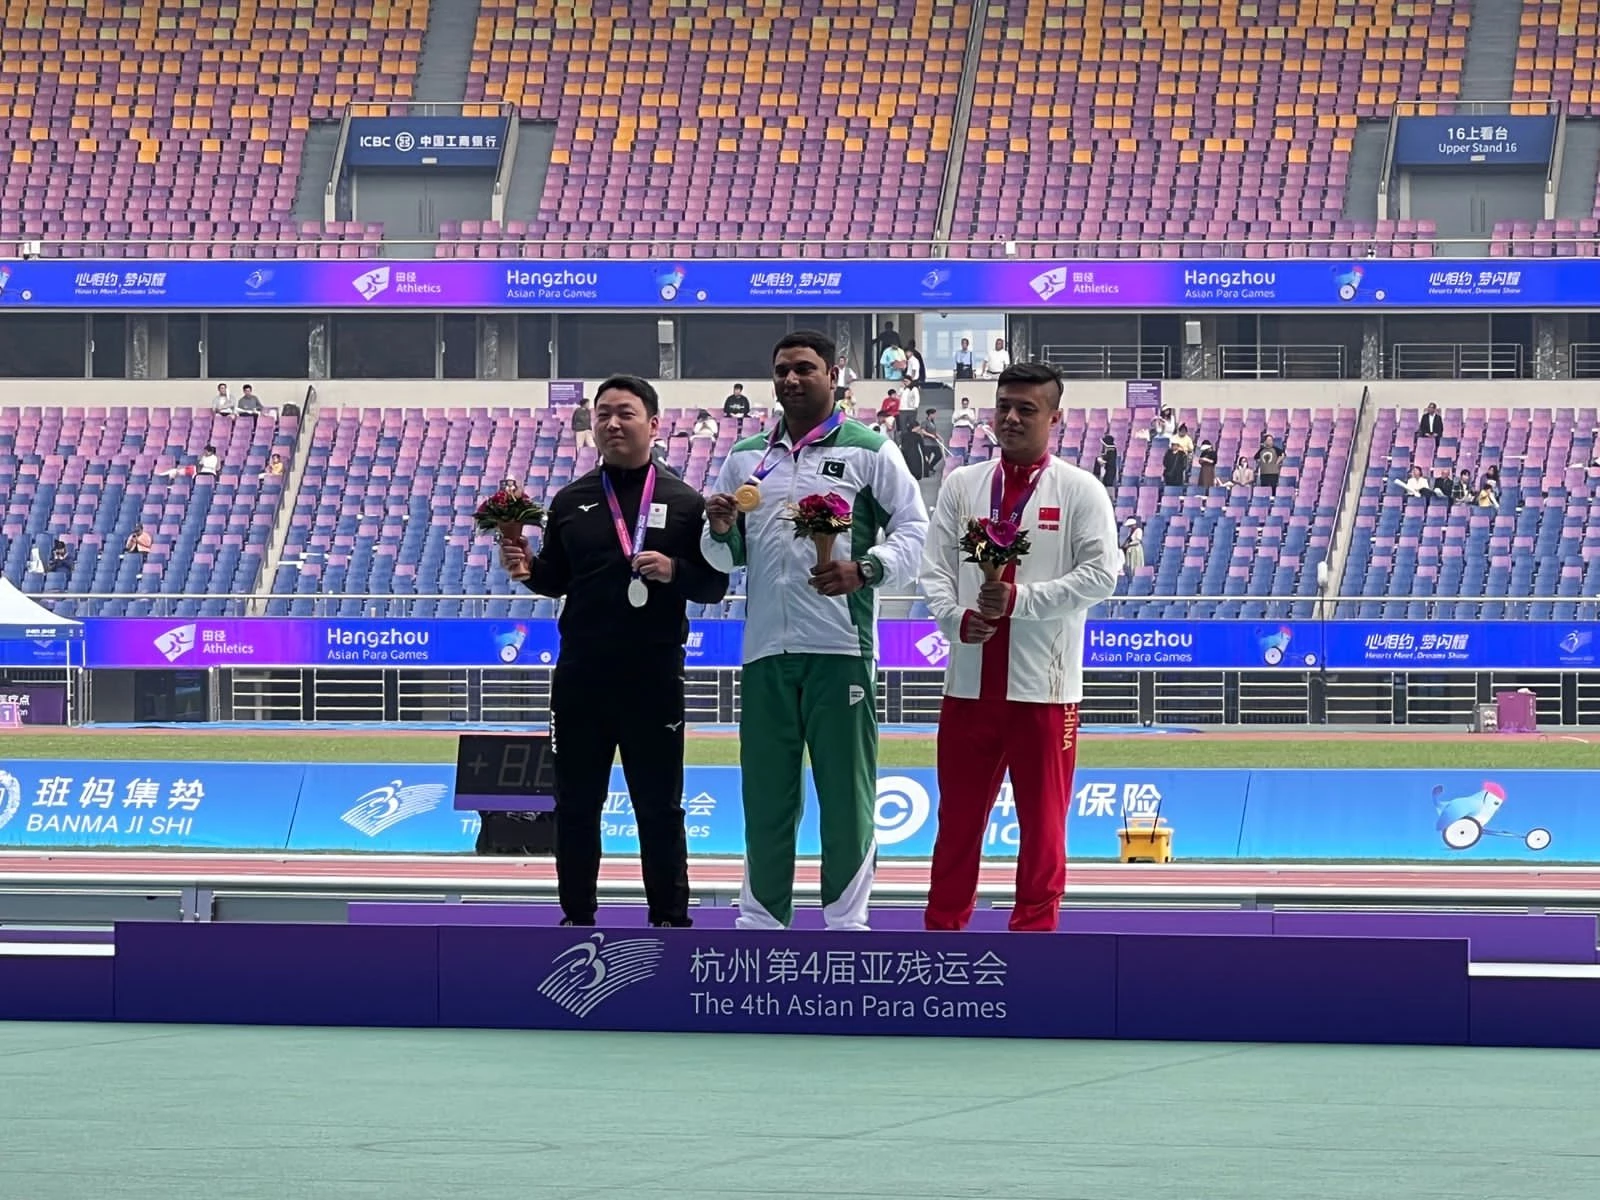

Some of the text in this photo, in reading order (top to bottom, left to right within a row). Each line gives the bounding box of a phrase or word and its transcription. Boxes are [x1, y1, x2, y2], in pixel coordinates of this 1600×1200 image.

[1448, 126, 1508, 140] 16上看台
[360, 136, 391, 147] ICBC
[420, 135, 497, 147] 中国工商银行
[1438, 142, 1517, 155] Upper Stand 16
[507, 269, 597, 287] Hangzhou
[1184, 269, 1276, 288] Hangzhou
[396, 284, 441, 293] Athletics
[507, 288, 597, 298] Asian Para Games
[1073, 284, 1119, 293] Athletics
[1185, 288, 1275, 298] Asian Para Games
[202, 630, 226, 641] 田径
[327, 628, 429, 648] Hangzhou
[1090, 630, 1192, 650] Hangzhou
[203, 643, 254, 655] Athletics
[327, 650, 428, 660] Asian Para Games
[1091, 651, 1192, 662] Asian Para Games
[1062, 703, 1076, 751] CHINA
[32, 776, 205, 811] 班妈集势
[26, 814, 192, 836] BANMA JI SHI
[689, 947, 1008, 987] 杭州第4届亚残运会
[690, 992, 1007, 1019] The 4th Asian Para Games
